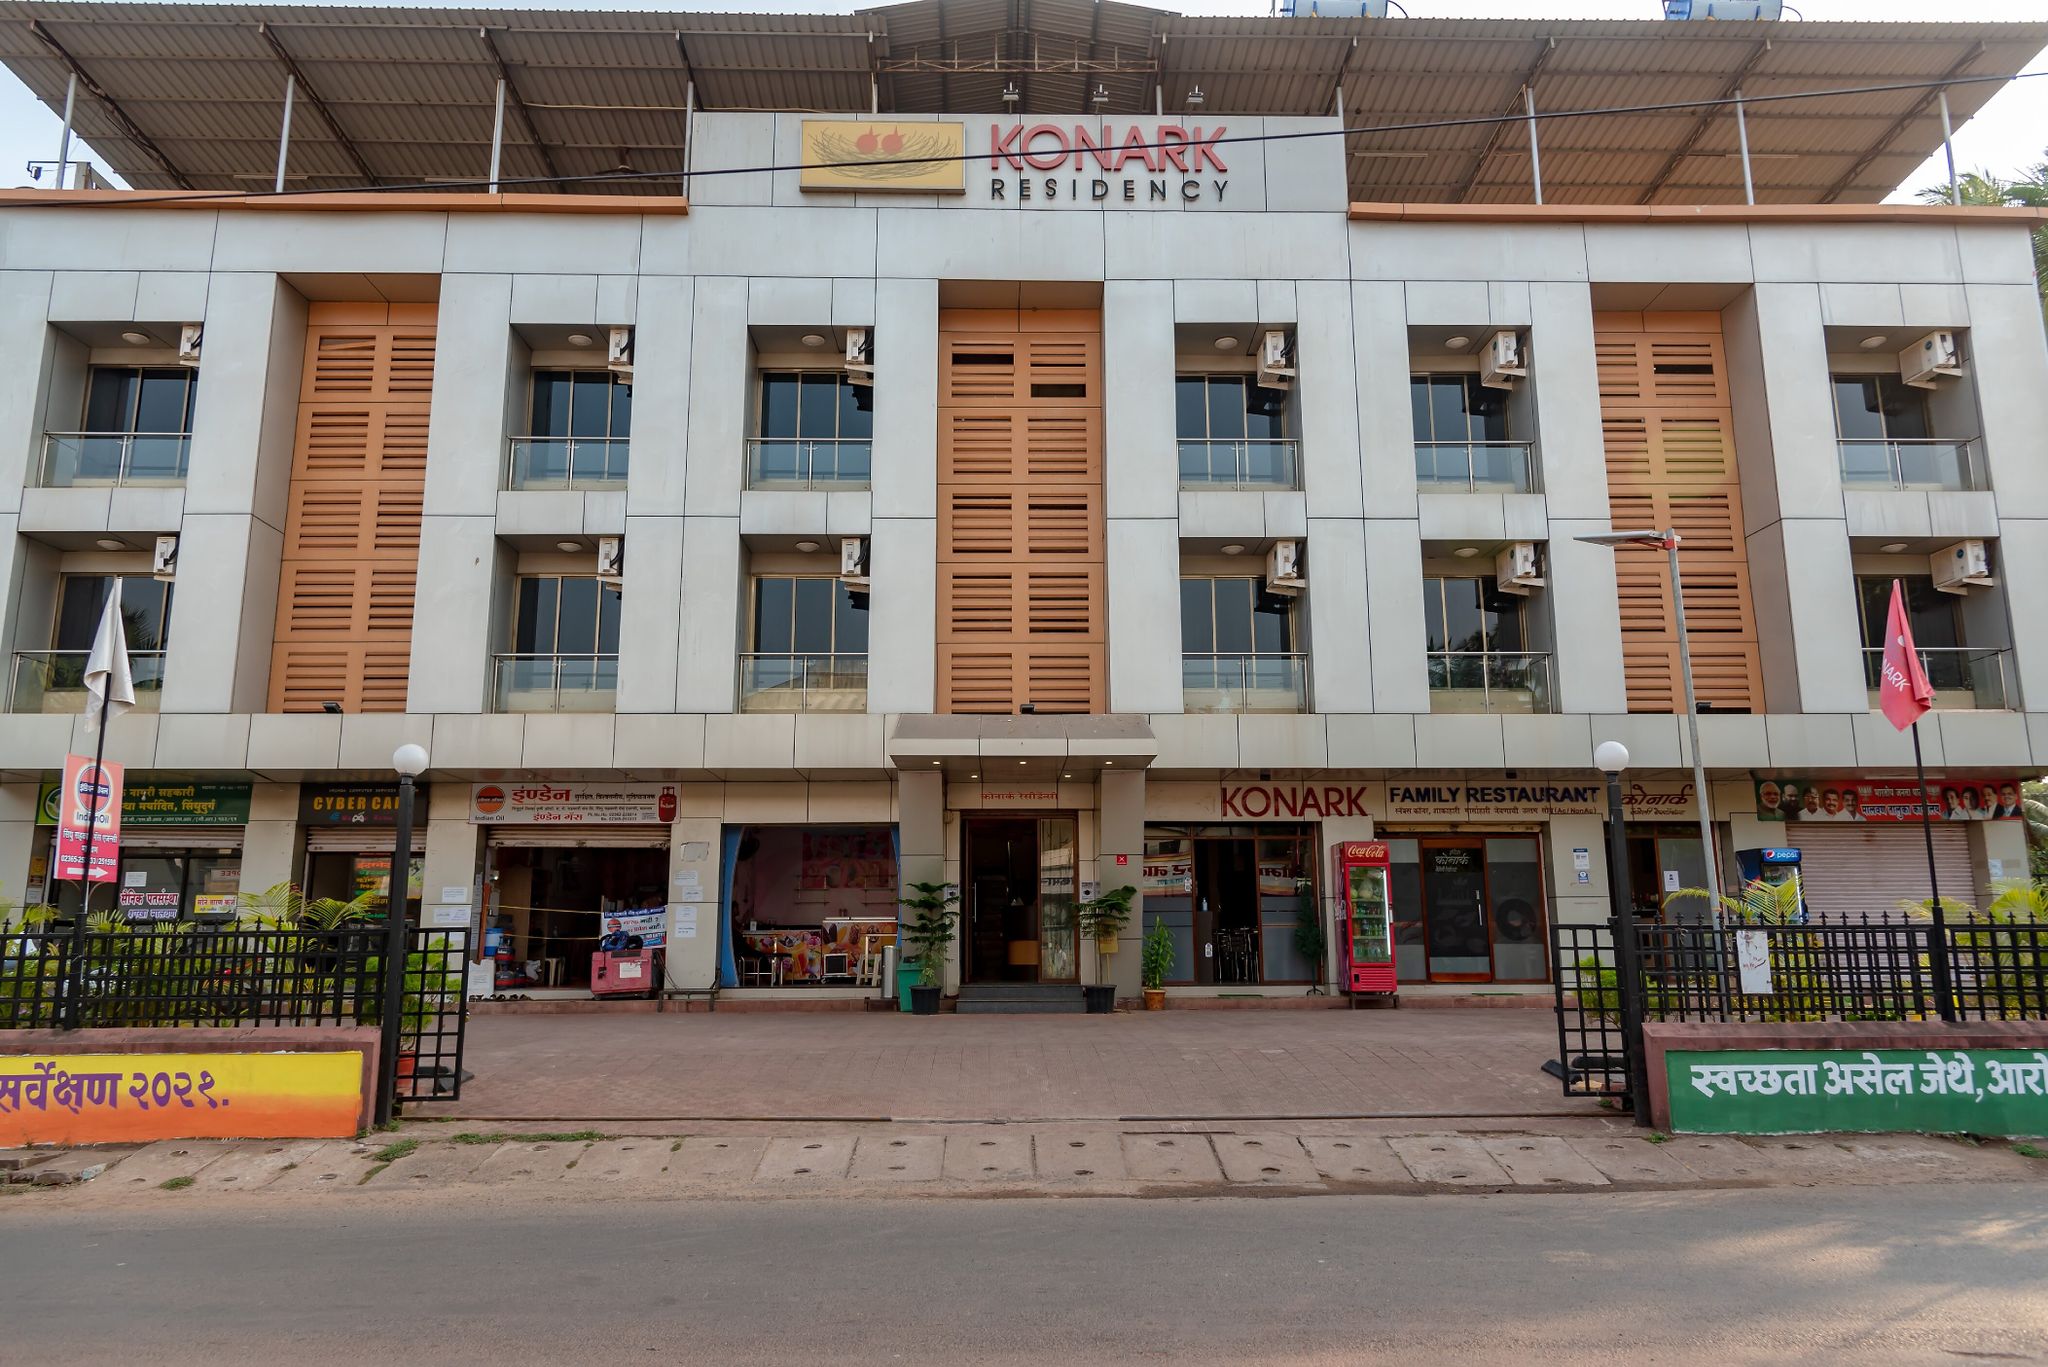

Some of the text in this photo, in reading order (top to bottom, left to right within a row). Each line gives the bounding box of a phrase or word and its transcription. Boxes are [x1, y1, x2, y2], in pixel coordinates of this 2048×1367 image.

[991, 124, 1227, 172] KONARK
[992, 178, 1229, 200] RESIDENCY
[158, 786, 195, 797] सहकारी
[981, 791, 1015, 800] कोनार्क
[1389, 787, 1600, 803] FAMILY RESTAURANT
[1622, 784, 1694, 805] कोनार्क
[313, 796, 367, 810] CYBER
[1222, 786, 1368, 817] KONARK
[76, 812, 109, 823] IndnOil
[1860, 804, 1887, 816] मालवण
[1887, 804, 1911, 820] तालुका
[1347, 845, 1385, 858] Coca-Cola
[1435, 852, 1471, 865] कोनार्क
[120, 888, 180, 906] सैनिक पतसंस्था
[1690, 1064, 1818, 1098] स्वच्छता
[1823, 1052, 1914, 1096] असेल
[1919, 1052, 1984, 1102] जेथे,
[0, 1061, 123, 1114] सर्वेक्षण
